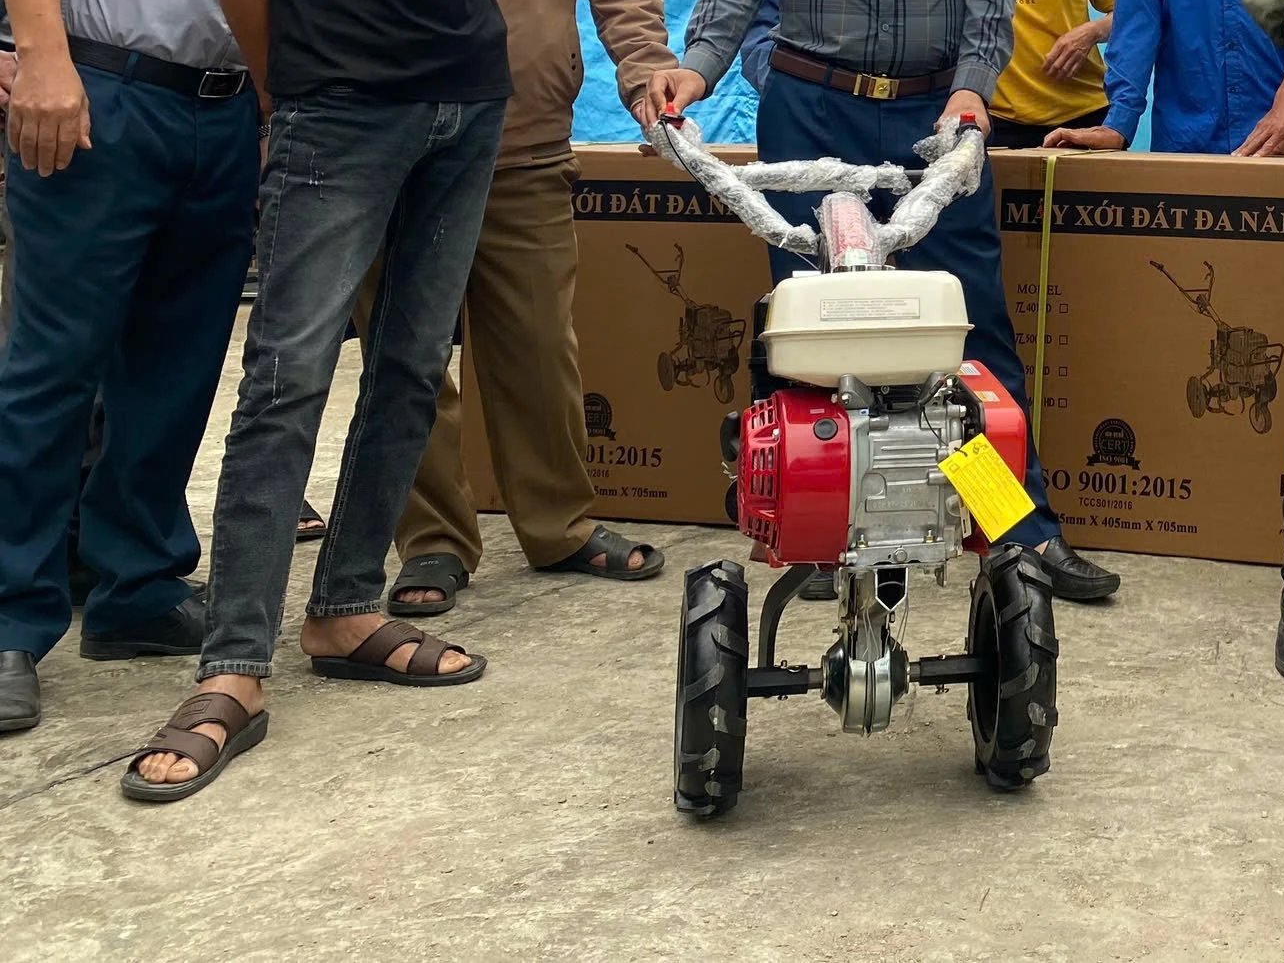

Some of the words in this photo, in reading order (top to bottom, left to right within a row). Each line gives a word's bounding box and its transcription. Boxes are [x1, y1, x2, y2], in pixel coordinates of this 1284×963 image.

[609, 188, 661, 214] ĐẤT
[666, 194, 703, 215] ĐA
[1074, 199, 1125, 228] XỚI
[1131, 201, 1188, 230] ĐẤT
[1194, 208, 1234, 232] ĐA
[1042, 469, 1071, 491] SO
[1078, 470, 1193, 500] 9001:2015
[1078, 496, 1133, 510] TCCS01/2016
[1089, 515, 1099, 527] X
[1101, 516, 1142, 531] 405mm
[1145, 520, 1154, 531] X
[1157, 520, 1198, 534] 705mm
